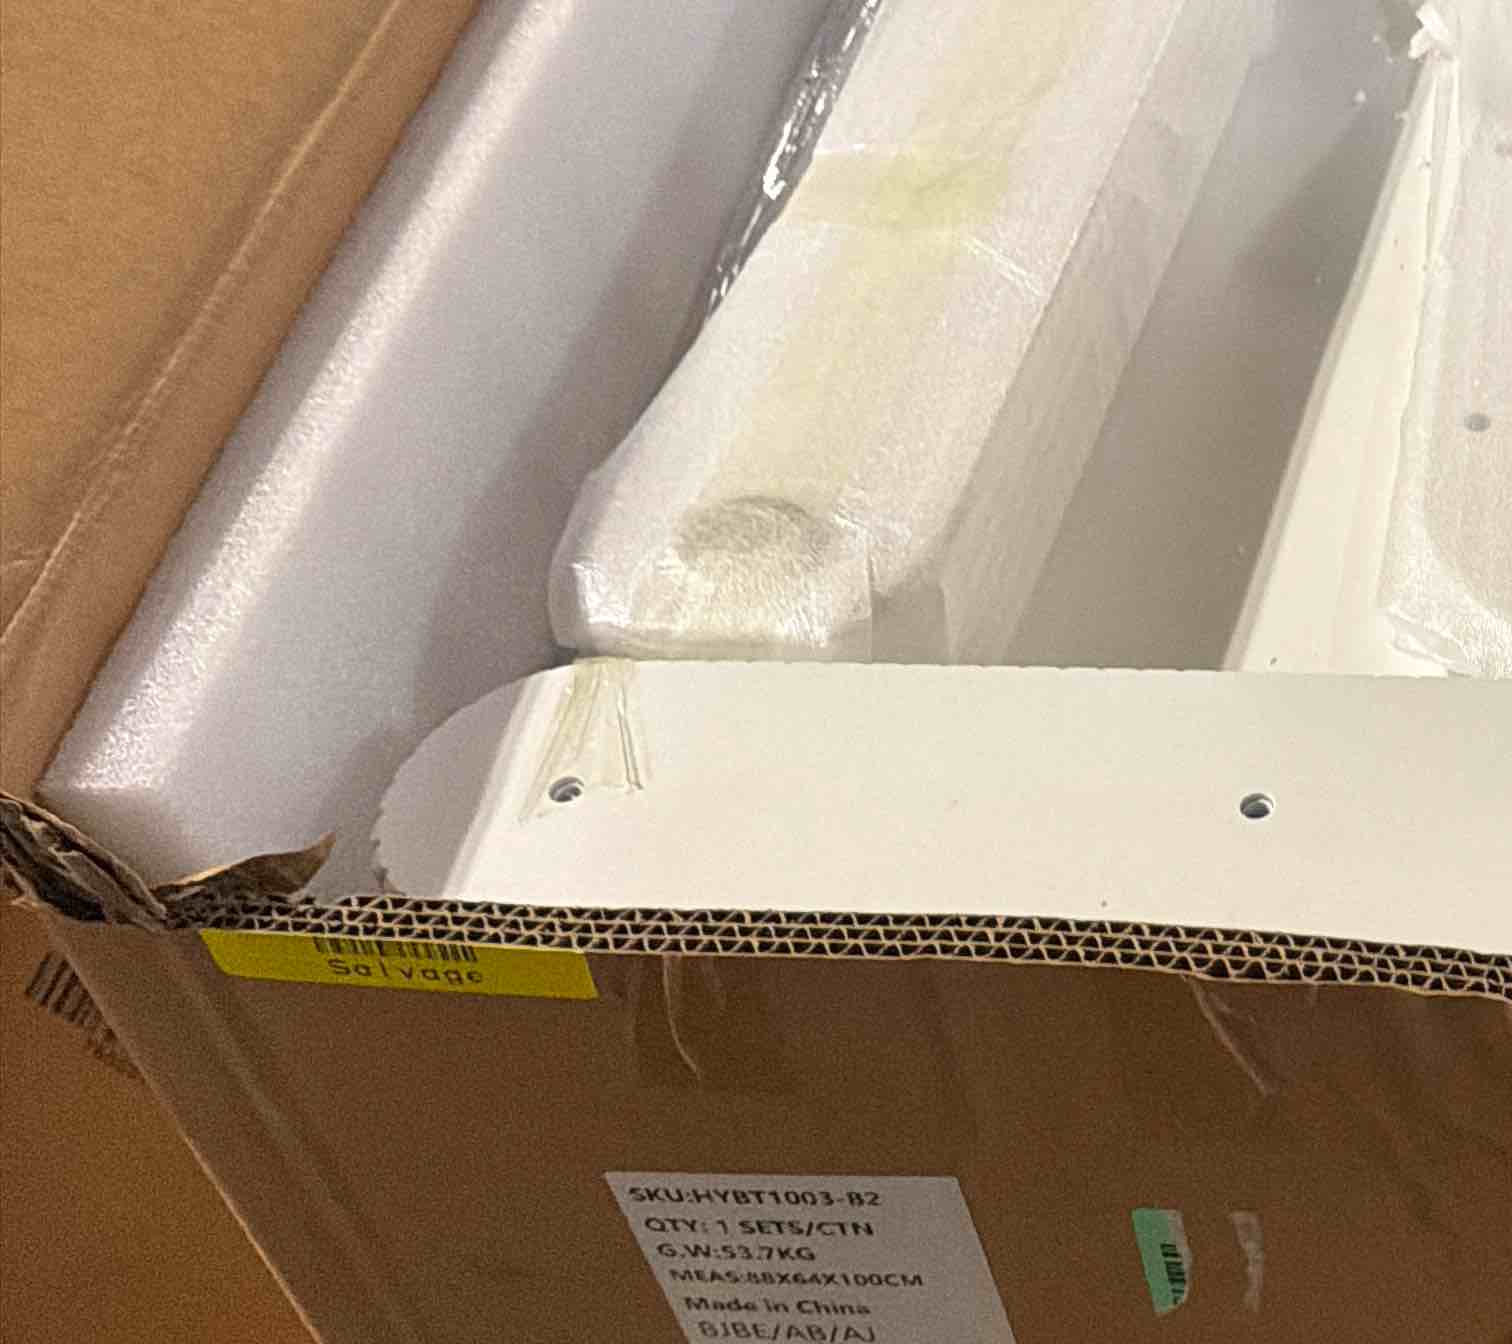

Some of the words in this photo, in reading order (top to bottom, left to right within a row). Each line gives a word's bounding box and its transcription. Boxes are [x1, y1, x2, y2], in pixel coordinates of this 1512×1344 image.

[326, 958, 485, 986] Salvage
[628, 1186, 882, 1206] SKU:HYBT1003-B2
[644, 1216, 709, 1233] QTY:
[716, 1219, 729, 1235] 1
[738, 1219, 875, 1237] SETS/CTN
[656, 1242, 817, 1261] G.W:53.7KG
[684, 1296, 757, 1313] Made
[762, 1297, 790, 1313] in
[796, 1298, 872, 1316] China
